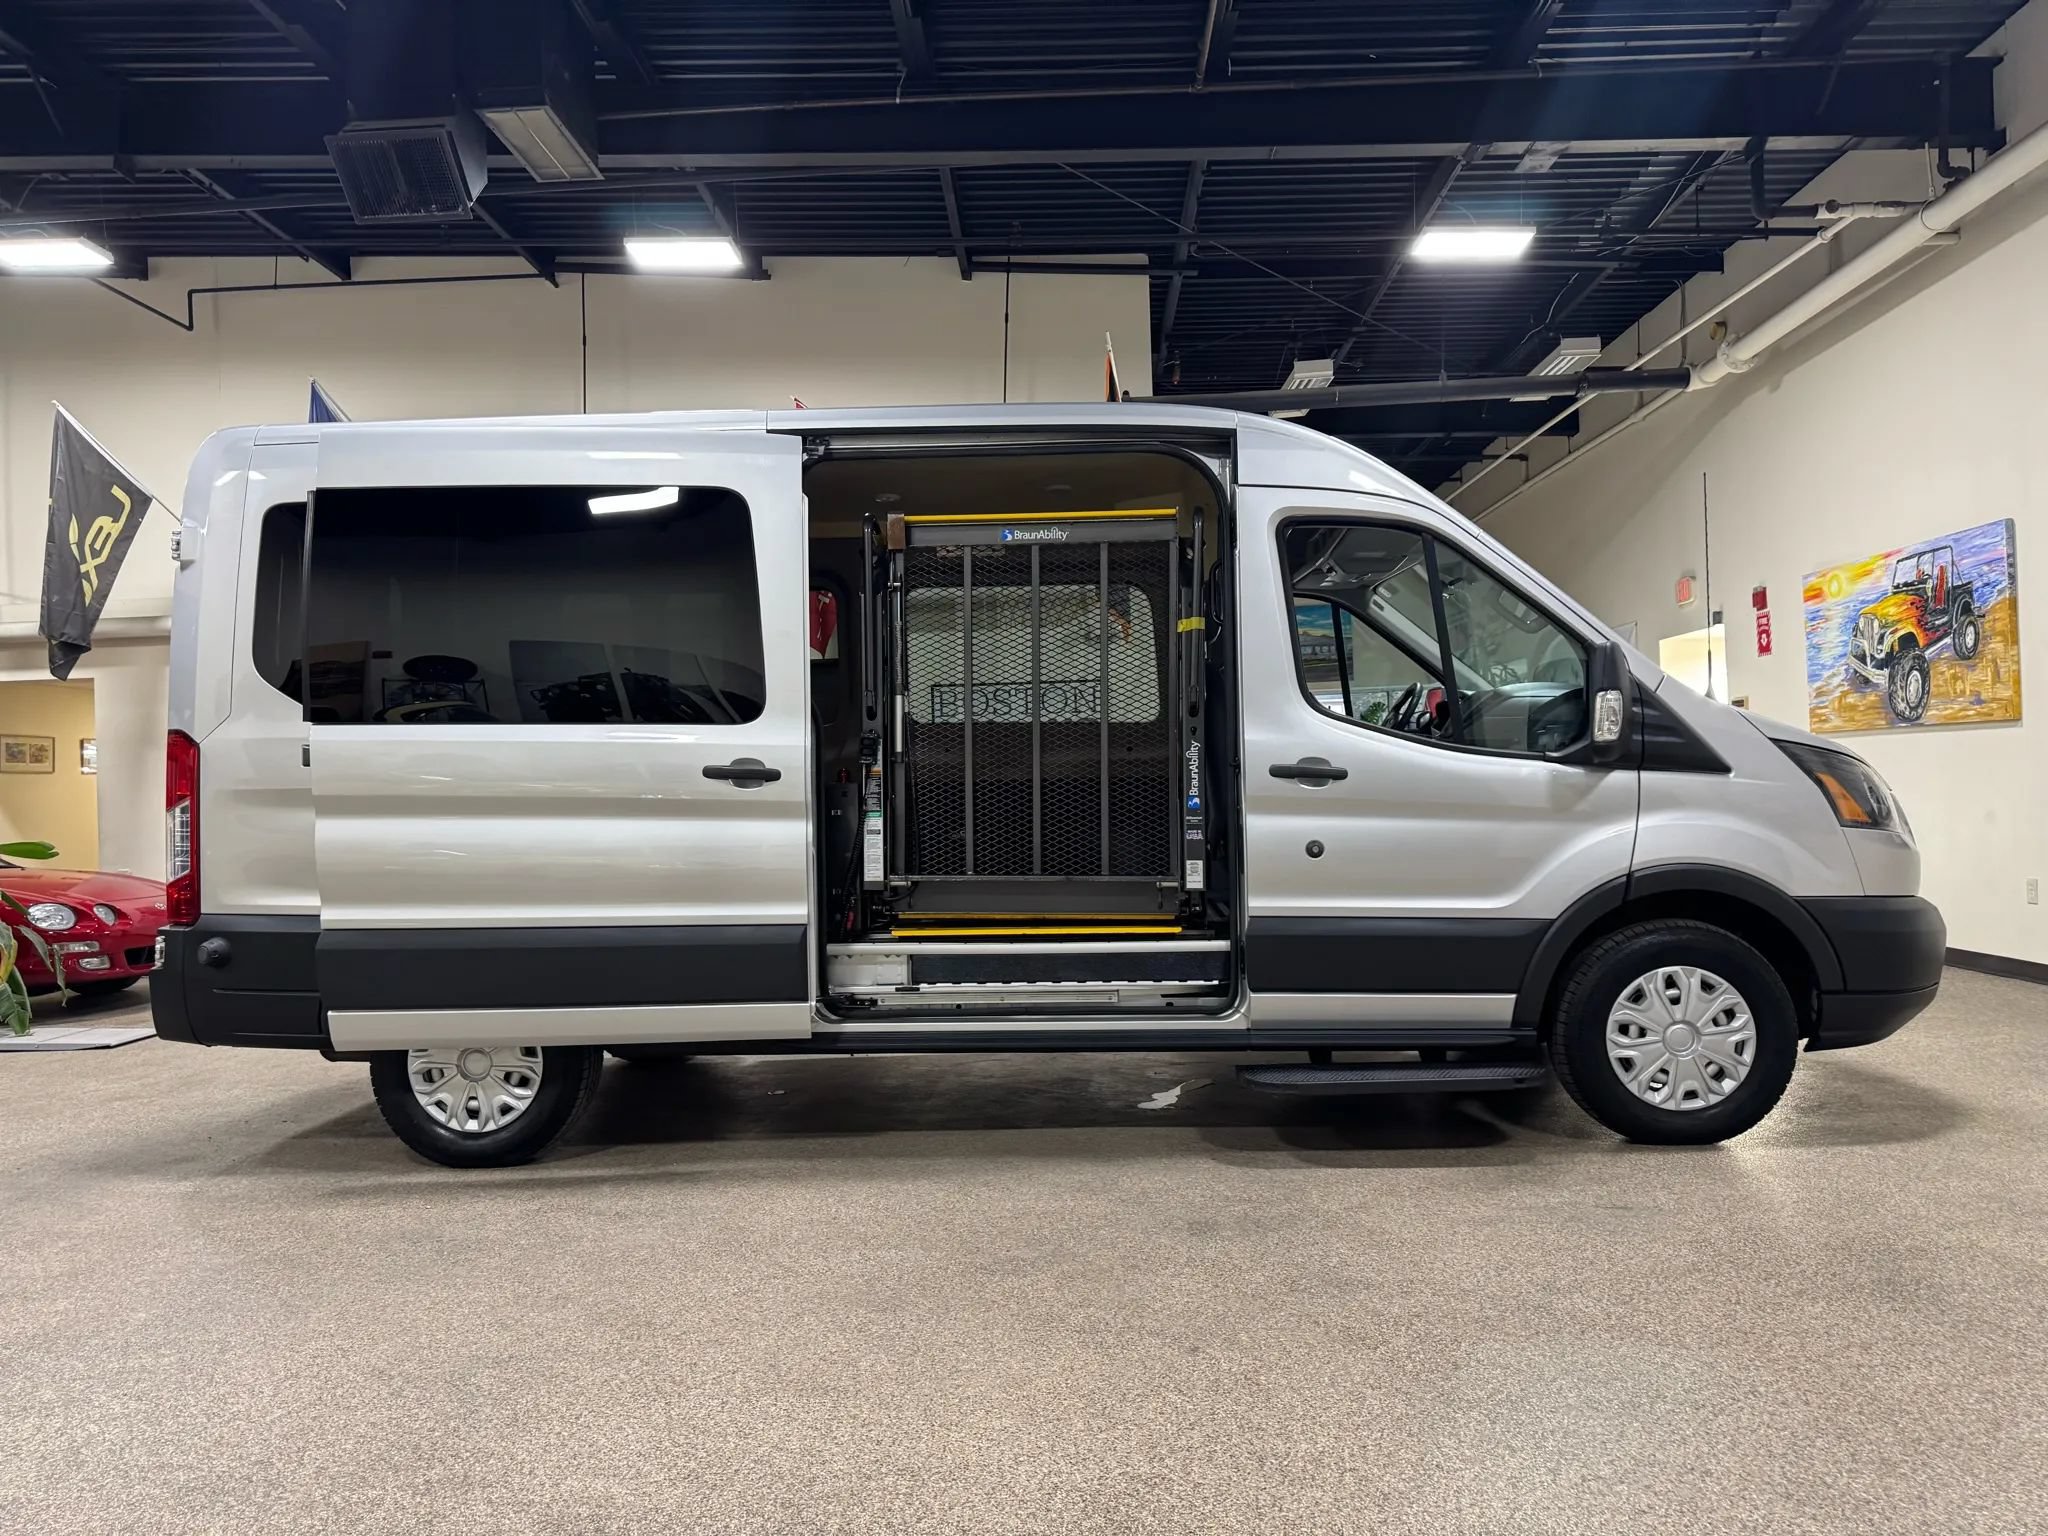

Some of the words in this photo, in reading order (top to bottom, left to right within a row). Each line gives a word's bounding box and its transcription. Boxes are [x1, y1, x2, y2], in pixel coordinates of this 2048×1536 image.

[1014, 526, 1068, 541] BraunAbility
[935, 686, 1098, 719] BOSTON
[1185, 740, 1201, 795] BraunAbility
